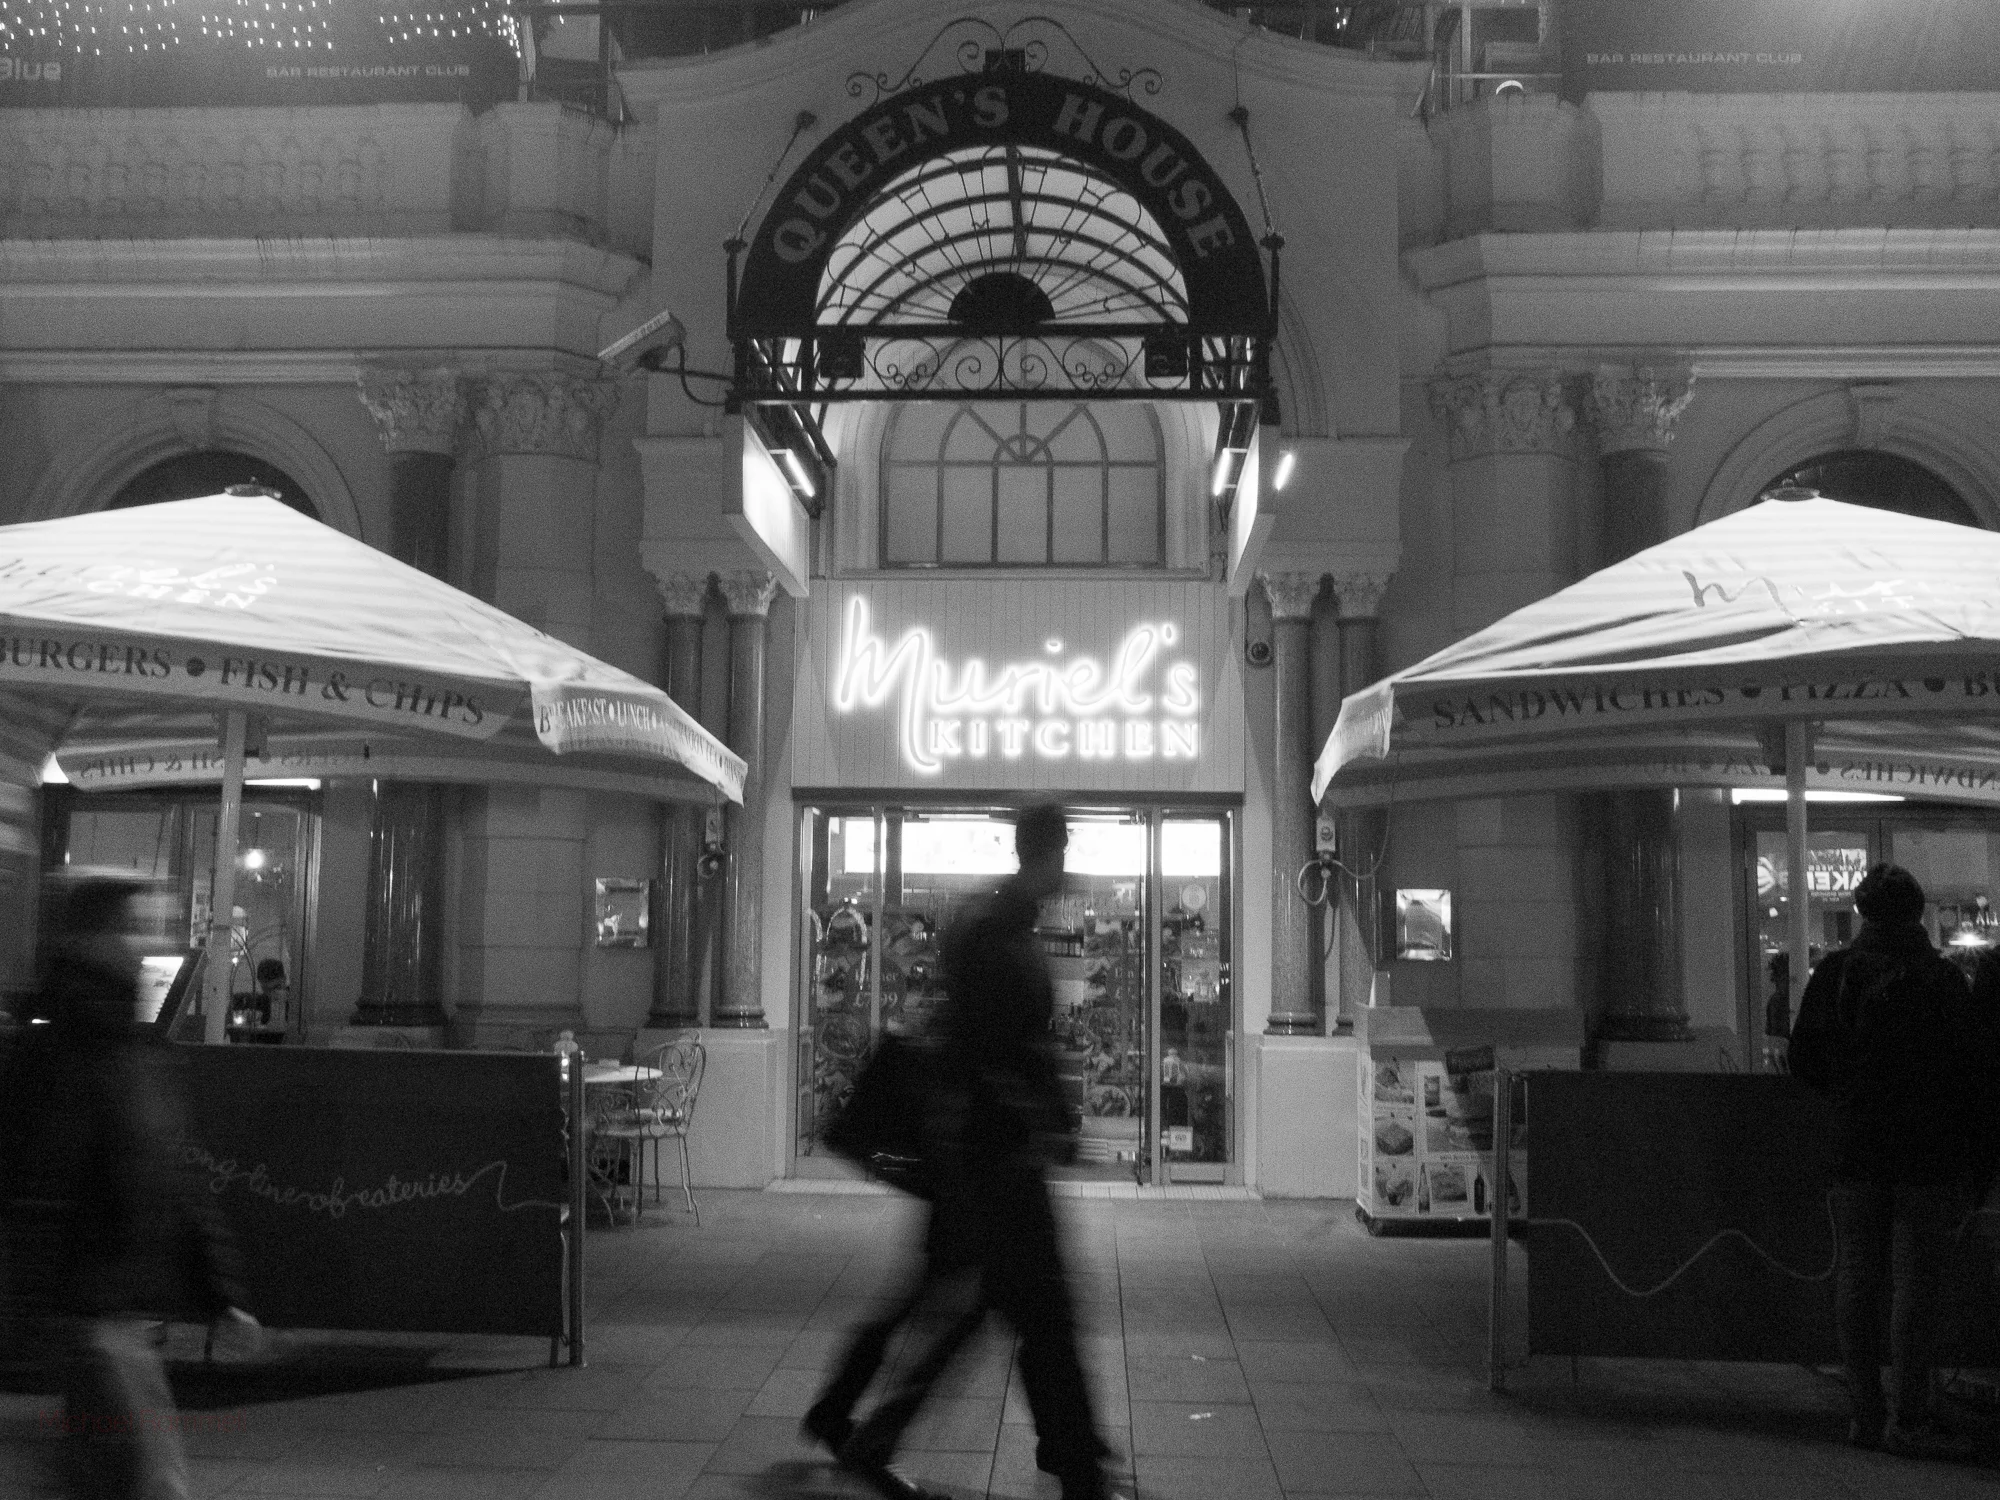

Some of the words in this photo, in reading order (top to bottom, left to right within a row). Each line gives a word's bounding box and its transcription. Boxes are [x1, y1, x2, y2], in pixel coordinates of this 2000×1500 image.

[266, 66, 300, 78] BAR
[307, 65, 418, 78] RESTAURANT
[425, 64, 470, 77] CLUB
[1586, 53, 1623, 65] BAR
[1630, 52, 1749, 65] RESTAURANT
[1756, 52, 1802, 64] CLUB
[772, 84, 1010, 264] QUEEN'S
[1051, 91, 1236, 260] HOUSE
[218, 656, 310, 696] FISH
[321, 671, 351, 703] &
[363, 677, 485, 727] CHIPS
[835, 595, 1202, 773] Muriel's
[615, 700, 651, 731] LUNCH
[1433, 685, 1725, 730] SANDWICHES
[928, 717, 1201, 759] KITCHEN
[180, 1146, 237, 1194] ong
[250, 1162, 297, 1204] line
[307, 1176, 349, 1217] of
[358, 1171, 468, 1208] eateries
